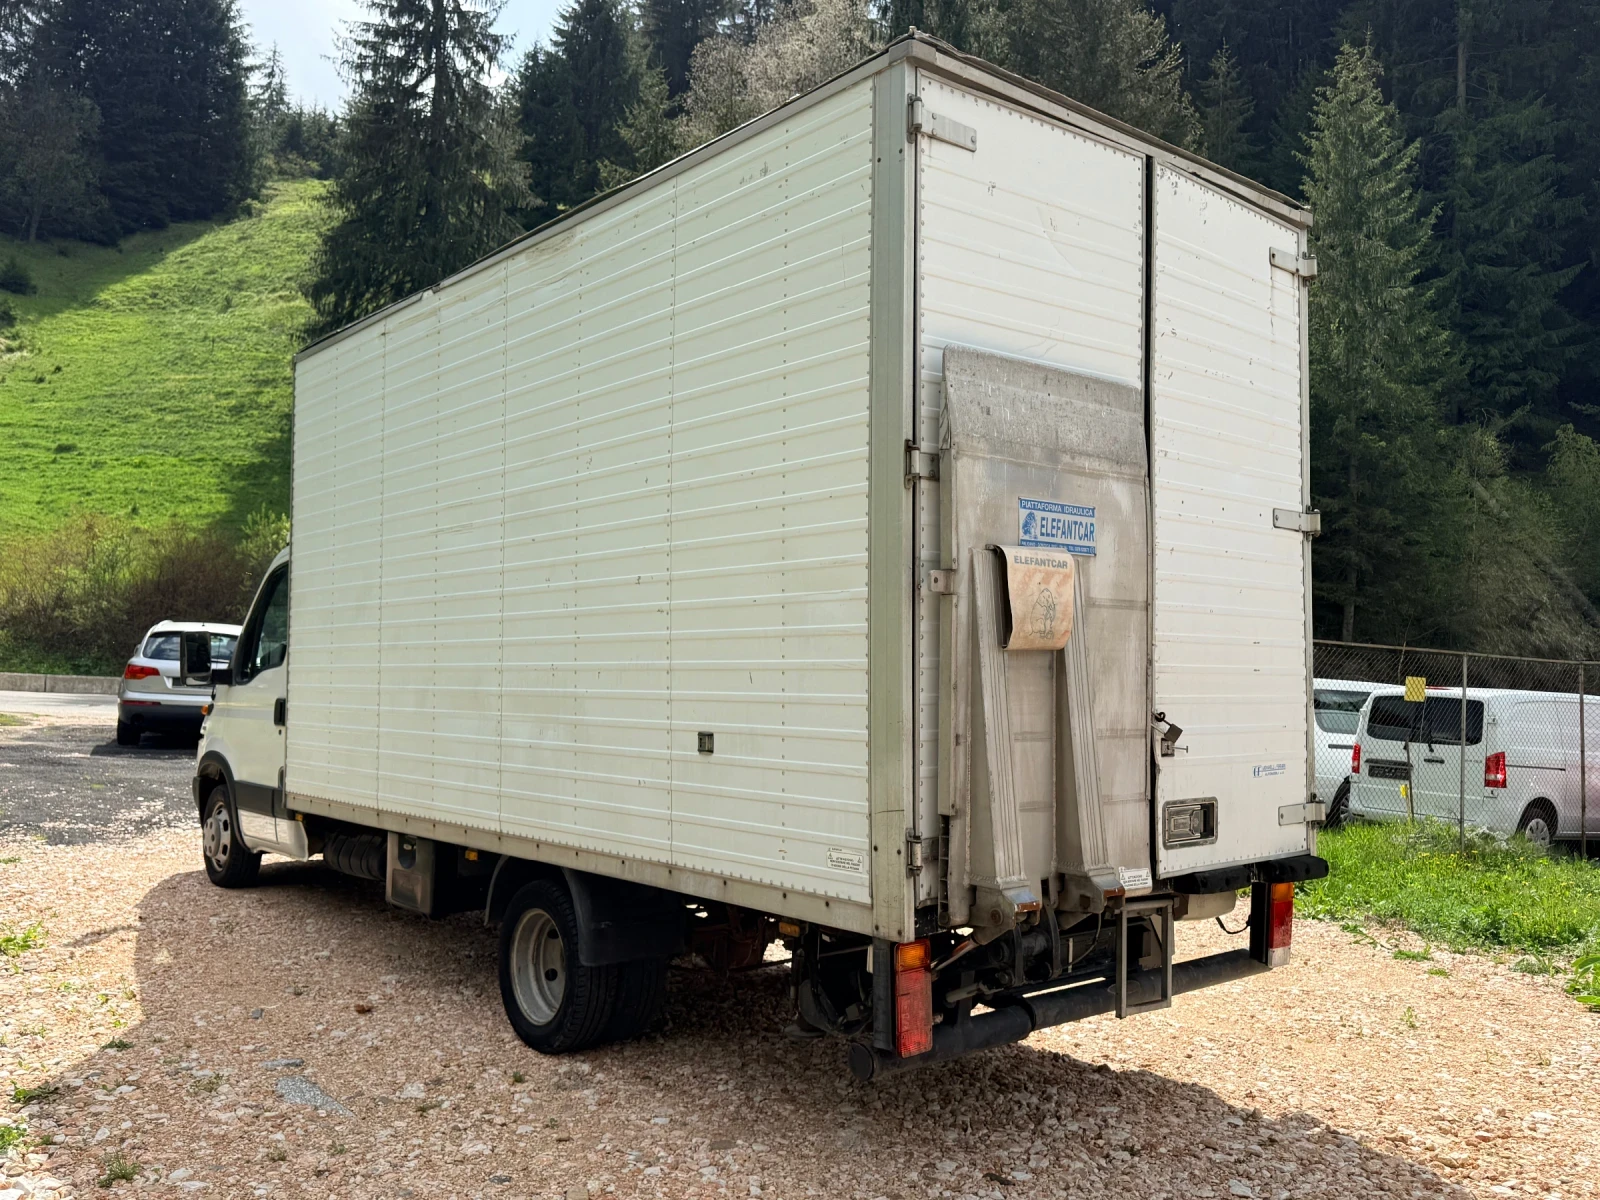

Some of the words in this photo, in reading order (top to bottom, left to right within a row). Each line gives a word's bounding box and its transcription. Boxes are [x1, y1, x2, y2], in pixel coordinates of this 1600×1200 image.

[1021, 500, 1062, 512] PIATTAFORMA
[1063, 506, 1093, 516] IDRAULICA
[1039, 516, 1095, 542] ELEFANTCAR
[1014, 556, 1068, 569] ELEFANTCAR
